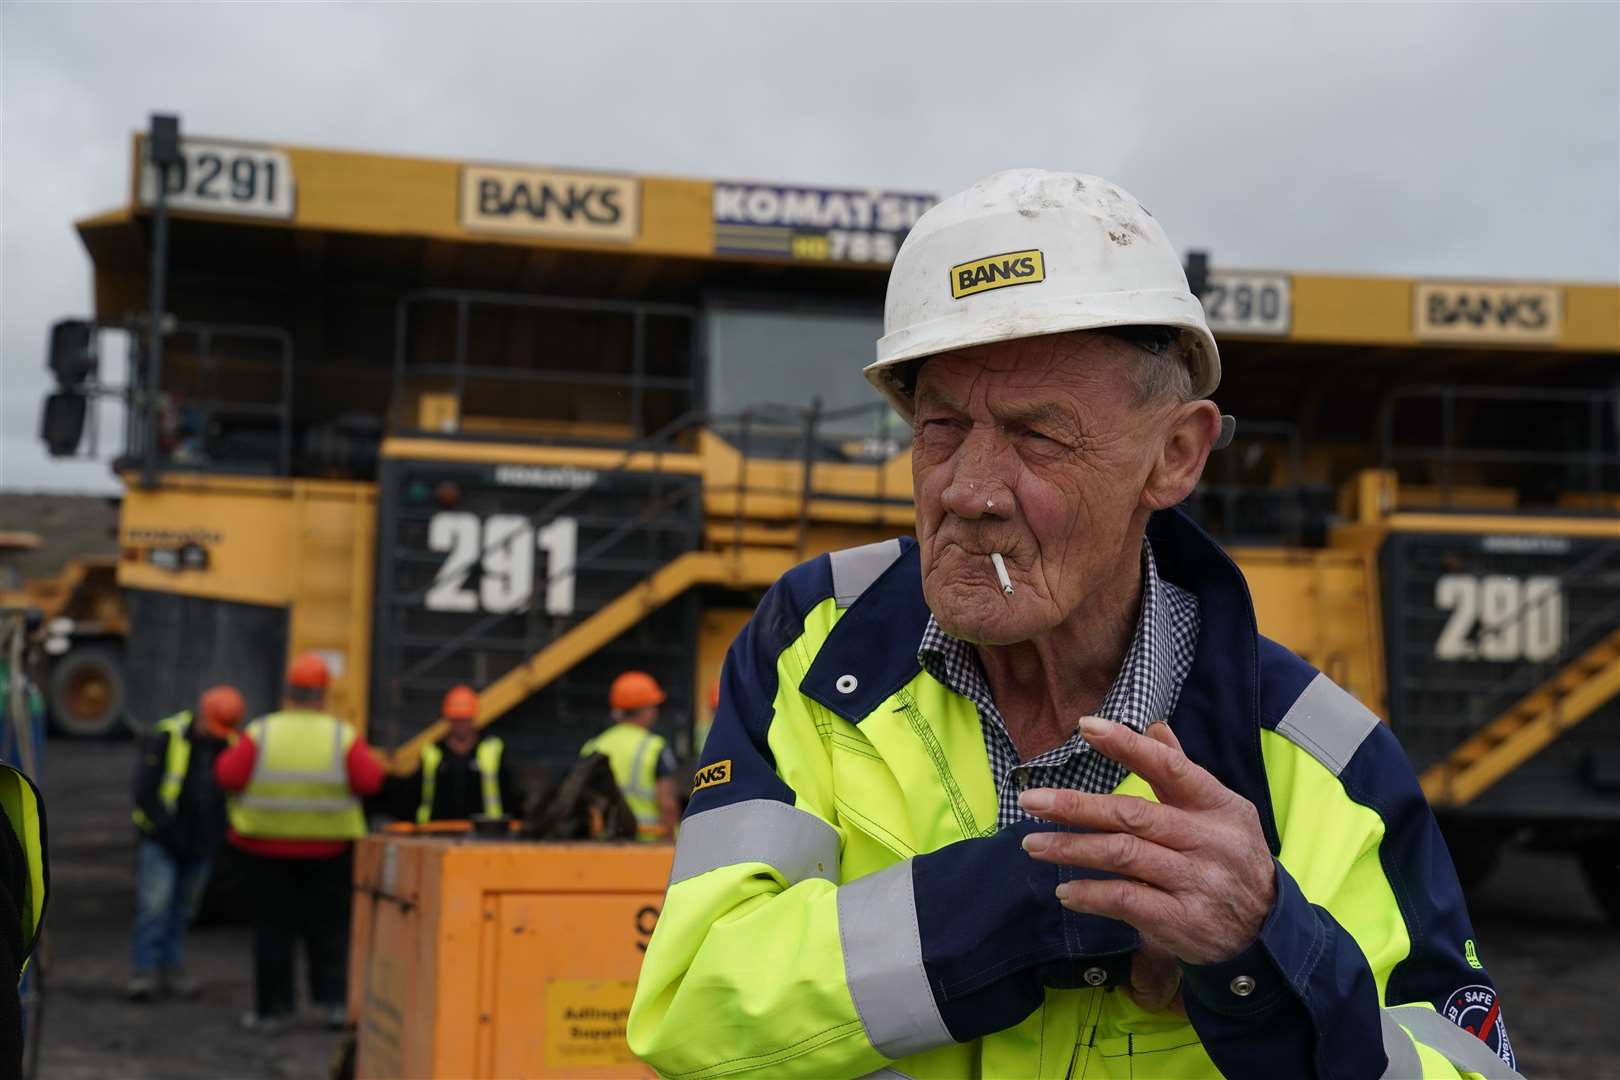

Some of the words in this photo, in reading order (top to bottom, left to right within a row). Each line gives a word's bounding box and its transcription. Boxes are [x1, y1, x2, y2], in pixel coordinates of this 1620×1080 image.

[478, 178, 622, 225] BANKS
[958, 257, 1036, 290] BANKS
[1427, 293, 1546, 331] BANKS
[426, 511, 577, 616] 291
[1435, 574, 1562, 663] 290
[1464, 991, 1493, 1006] SAFE
